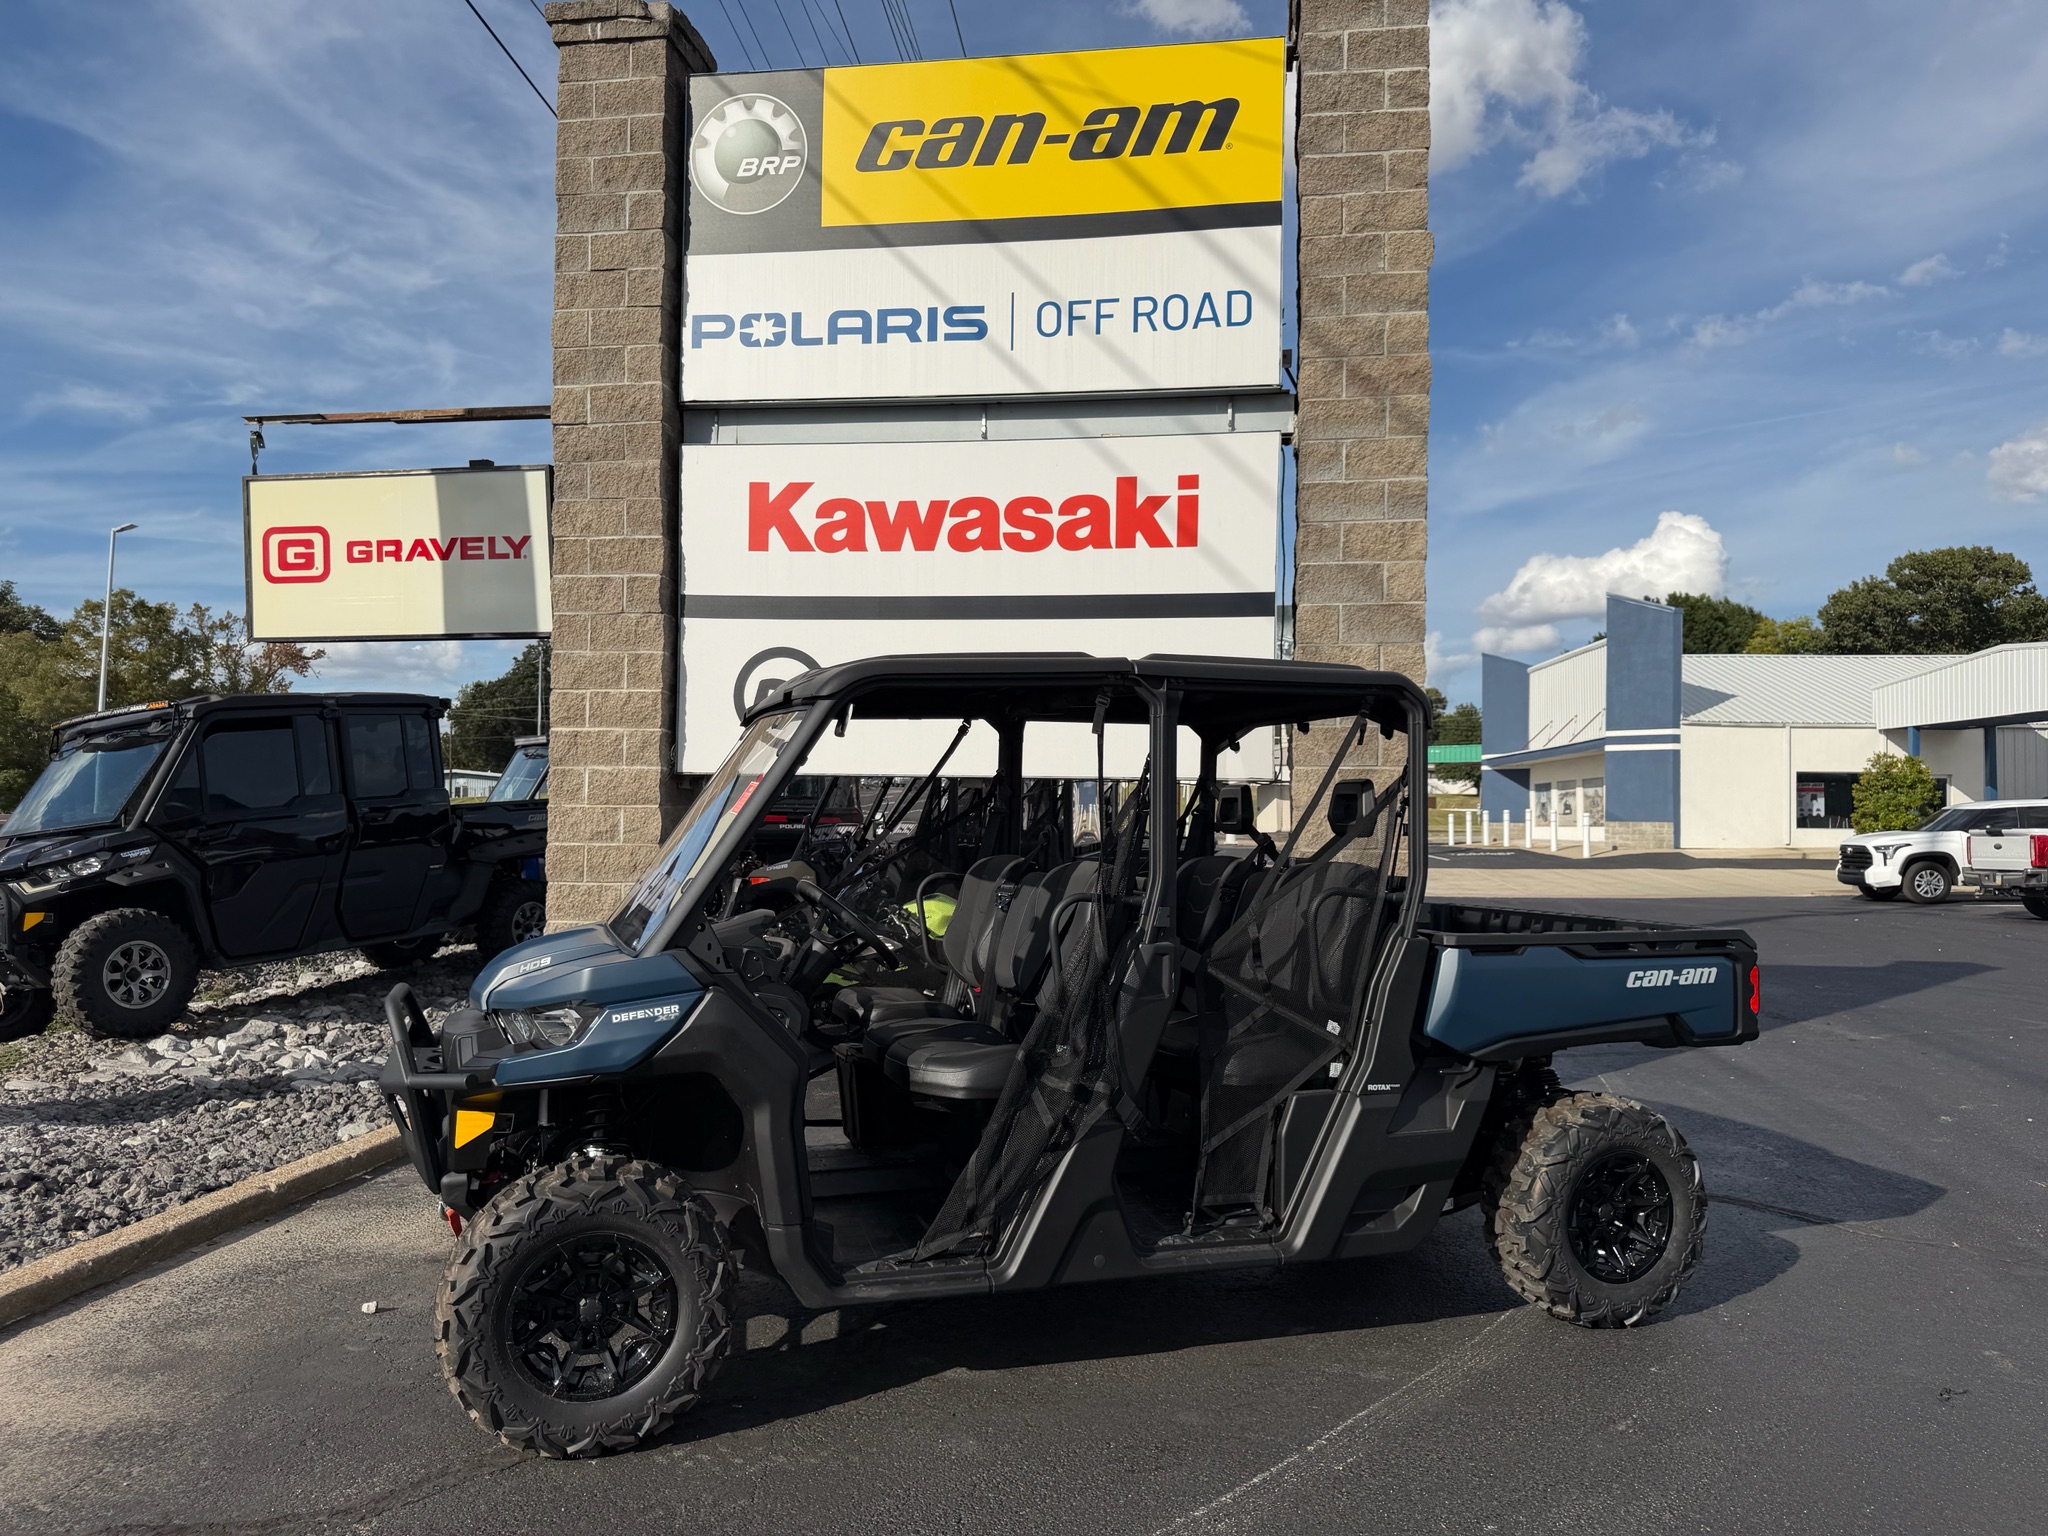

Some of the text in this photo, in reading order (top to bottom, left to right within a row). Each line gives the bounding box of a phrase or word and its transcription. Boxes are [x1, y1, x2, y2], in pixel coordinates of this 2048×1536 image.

[855, 97, 1240, 173] can-am
[736, 156, 802, 177] BRP
[1036, 289, 1253, 337] OFF ROAD
[691, 305, 988, 349] POLARIS
[748, 474, 1199, 553] Kawasaki
[346, 535, 531, 564] GRAVELY
[519, 957, 552, 973] HD9
[1626, 967, 1718, 988] can-am
[612, 1004, 680, 1023] DEFENDER
[654, 1012, 680, 1023] XT
